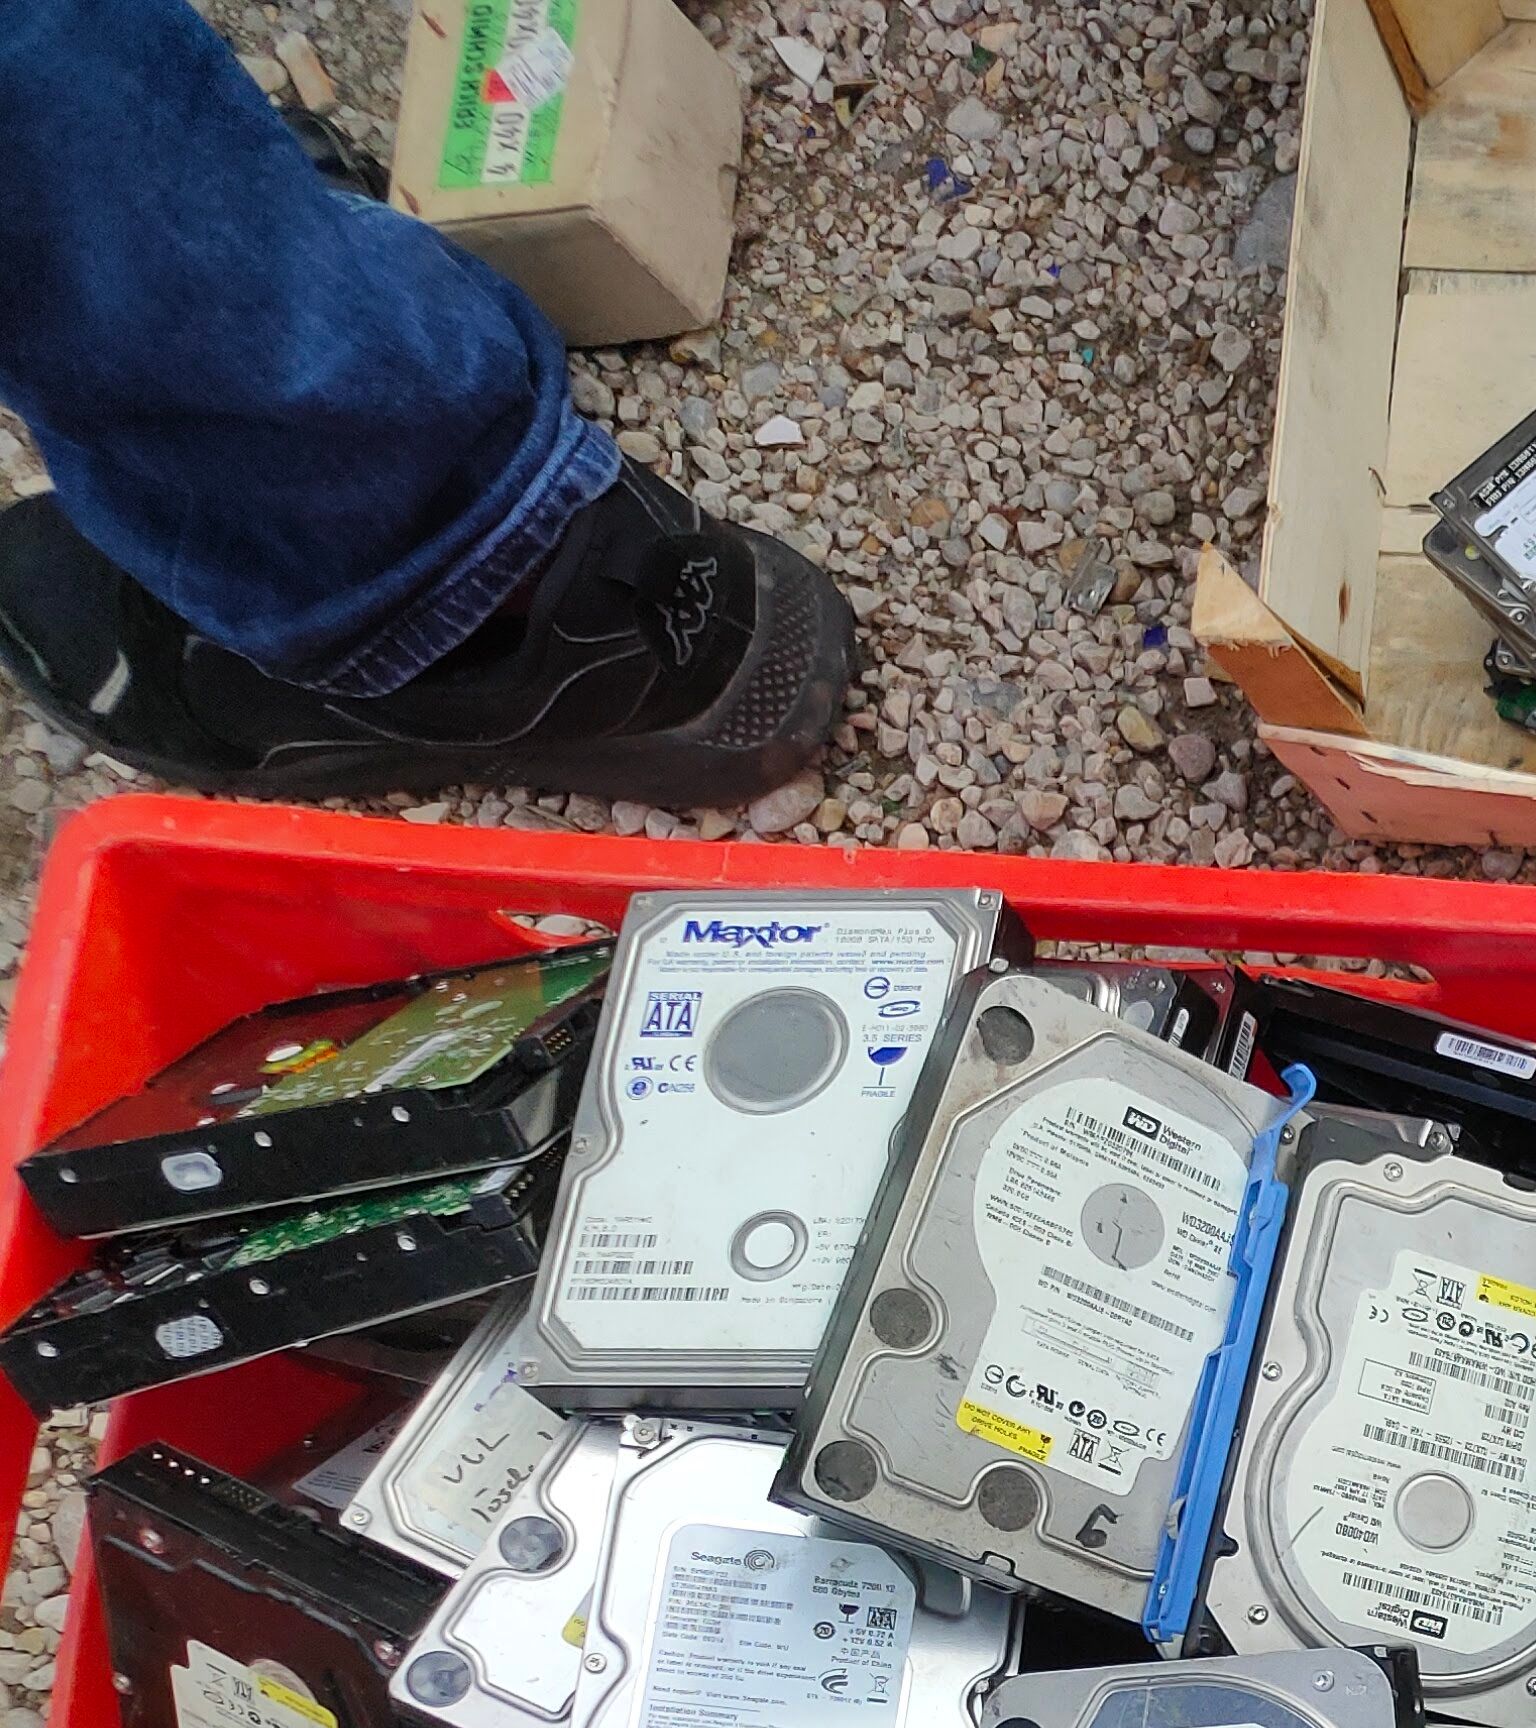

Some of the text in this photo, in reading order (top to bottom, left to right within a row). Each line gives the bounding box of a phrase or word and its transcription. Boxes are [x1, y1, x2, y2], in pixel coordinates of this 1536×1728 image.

[681, 921, 823, 948] Maxtor
[645, 1001, 694, 1032] ATA
[883, 1032, 922, 1044] SERIES
[861, 1089, 896, 1098] FRAGILE
[1124, 1110, 1159, 1137] WD
[1157, 1134, 1190, 1157] Digital
[1162, 1124, 1202, 1152] Western
[1438, 1276, 1464, 1300] ATA
[1144, 1426, 1167, 1448] CE
[1068, 1434, 1098, 1464] ATA
[690, 1550, 742, 1568] Seagate
[1366, 1607, 1407, 1629] Western
[1376, 1599, 1410, 1619] Digital
